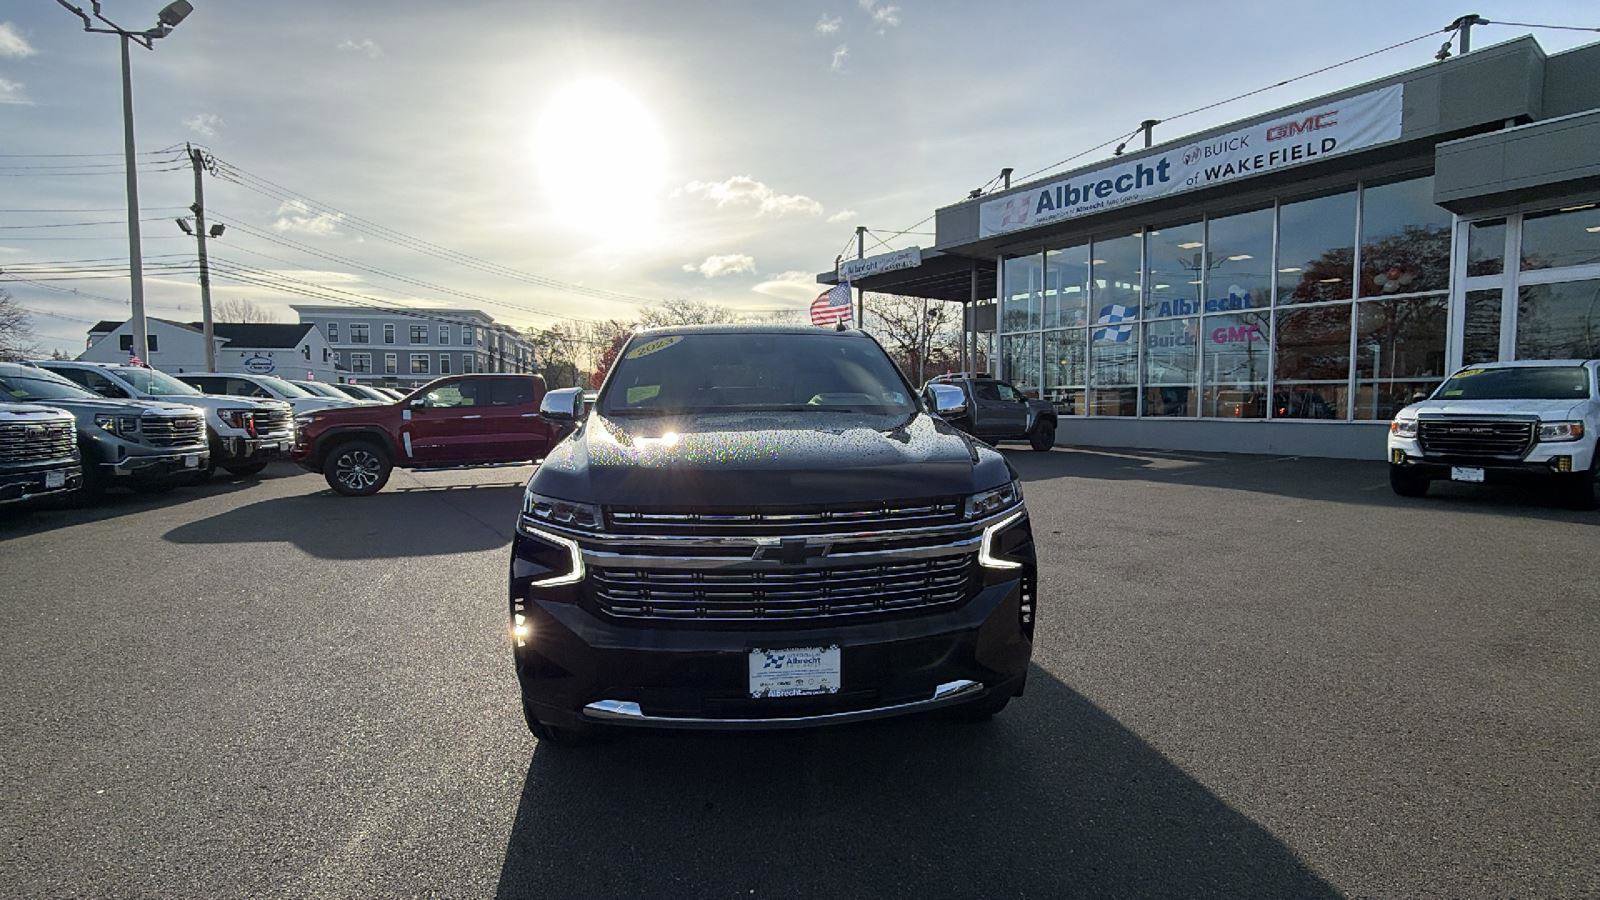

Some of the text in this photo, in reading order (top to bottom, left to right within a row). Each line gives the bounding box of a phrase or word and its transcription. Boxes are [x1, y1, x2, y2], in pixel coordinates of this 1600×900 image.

[1204, 110, 1339, 158] BUICK GMC
[1186, 137, 1337, 186] of WAKEFIELD
[1035, 157, 1170, 215] Albrecht
[1159, 292, 1252, 316] Albrecht
[1149, 323, 1261, 348] Buick GMC
[768, 689, 801, 698] Albrecht
